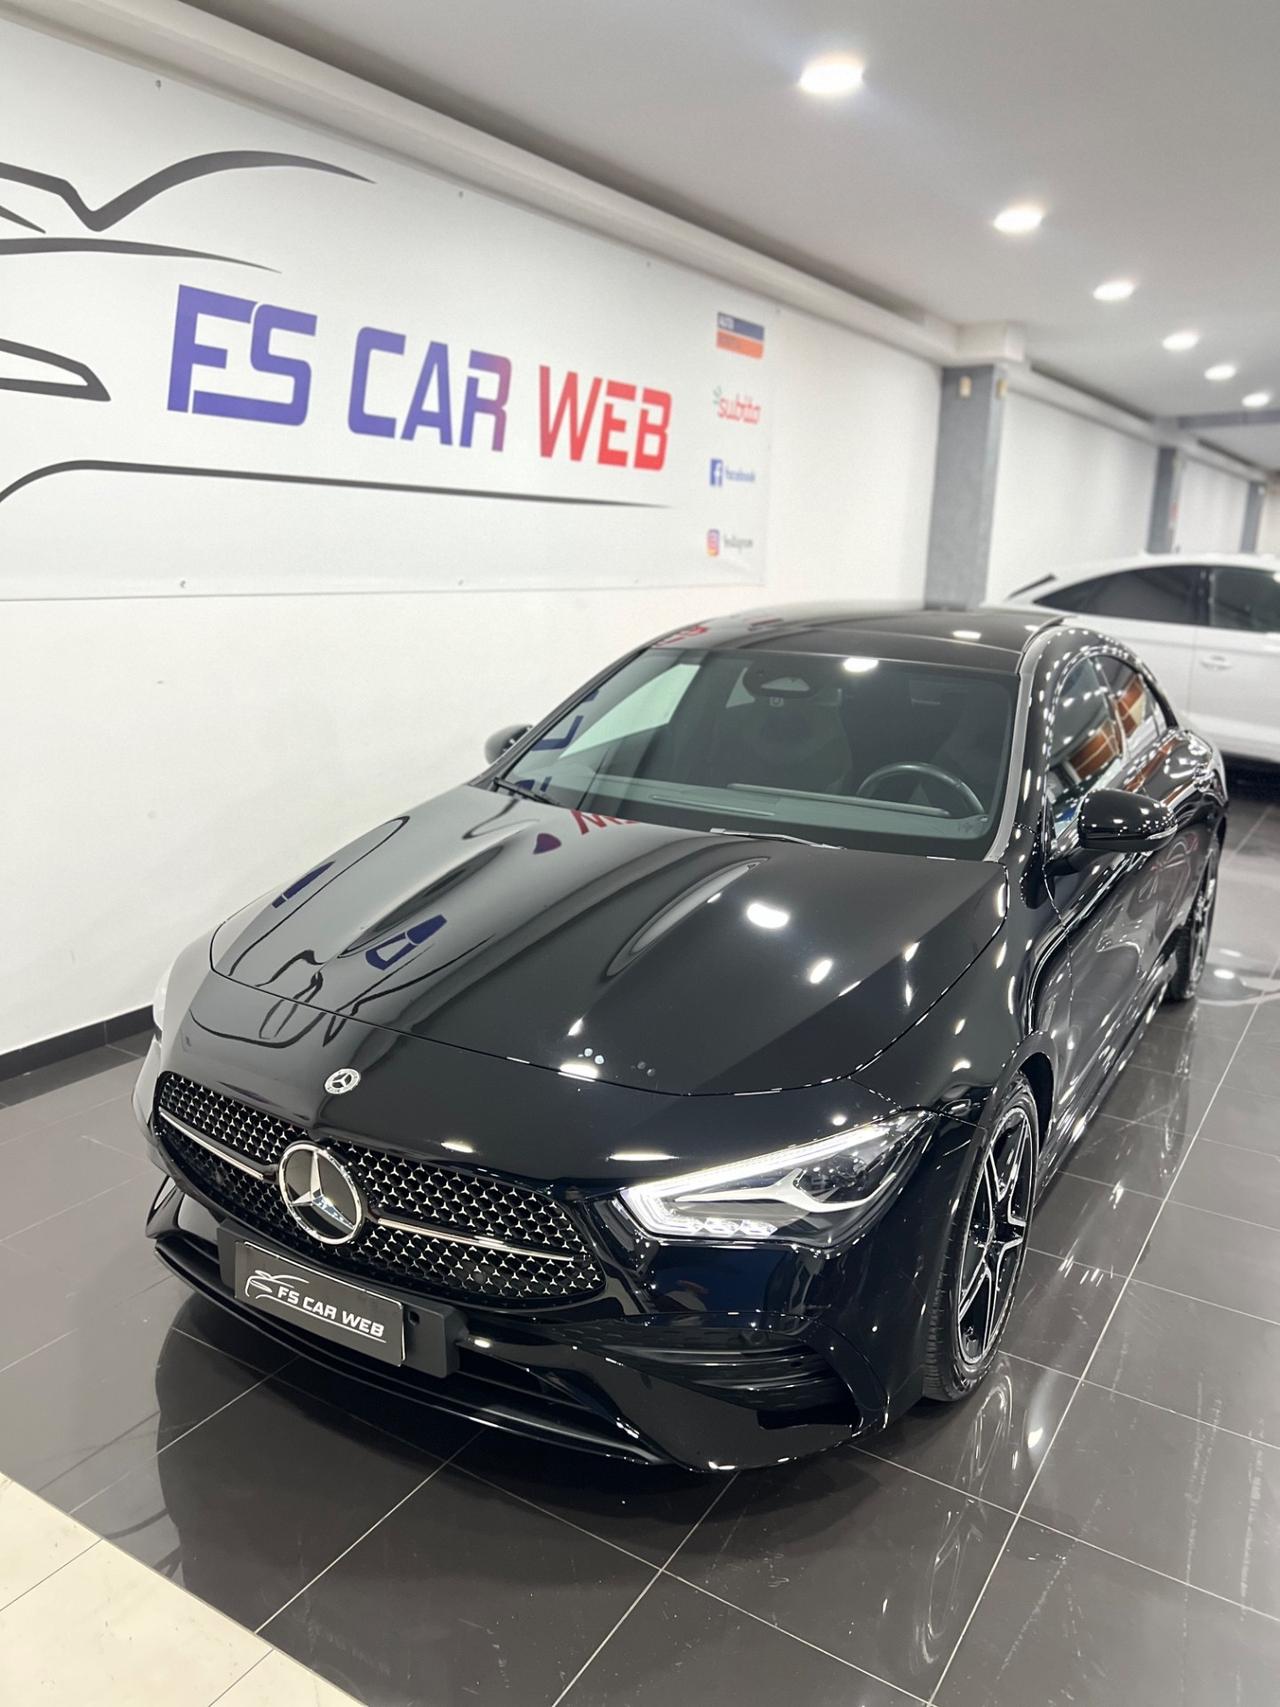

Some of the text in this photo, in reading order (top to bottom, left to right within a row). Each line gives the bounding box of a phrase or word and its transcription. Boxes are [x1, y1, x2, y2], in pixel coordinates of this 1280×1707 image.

[167, 284, 673, 471] FS CAR WEB
[277, 1286, 385, 1337] FS CAR WEB
